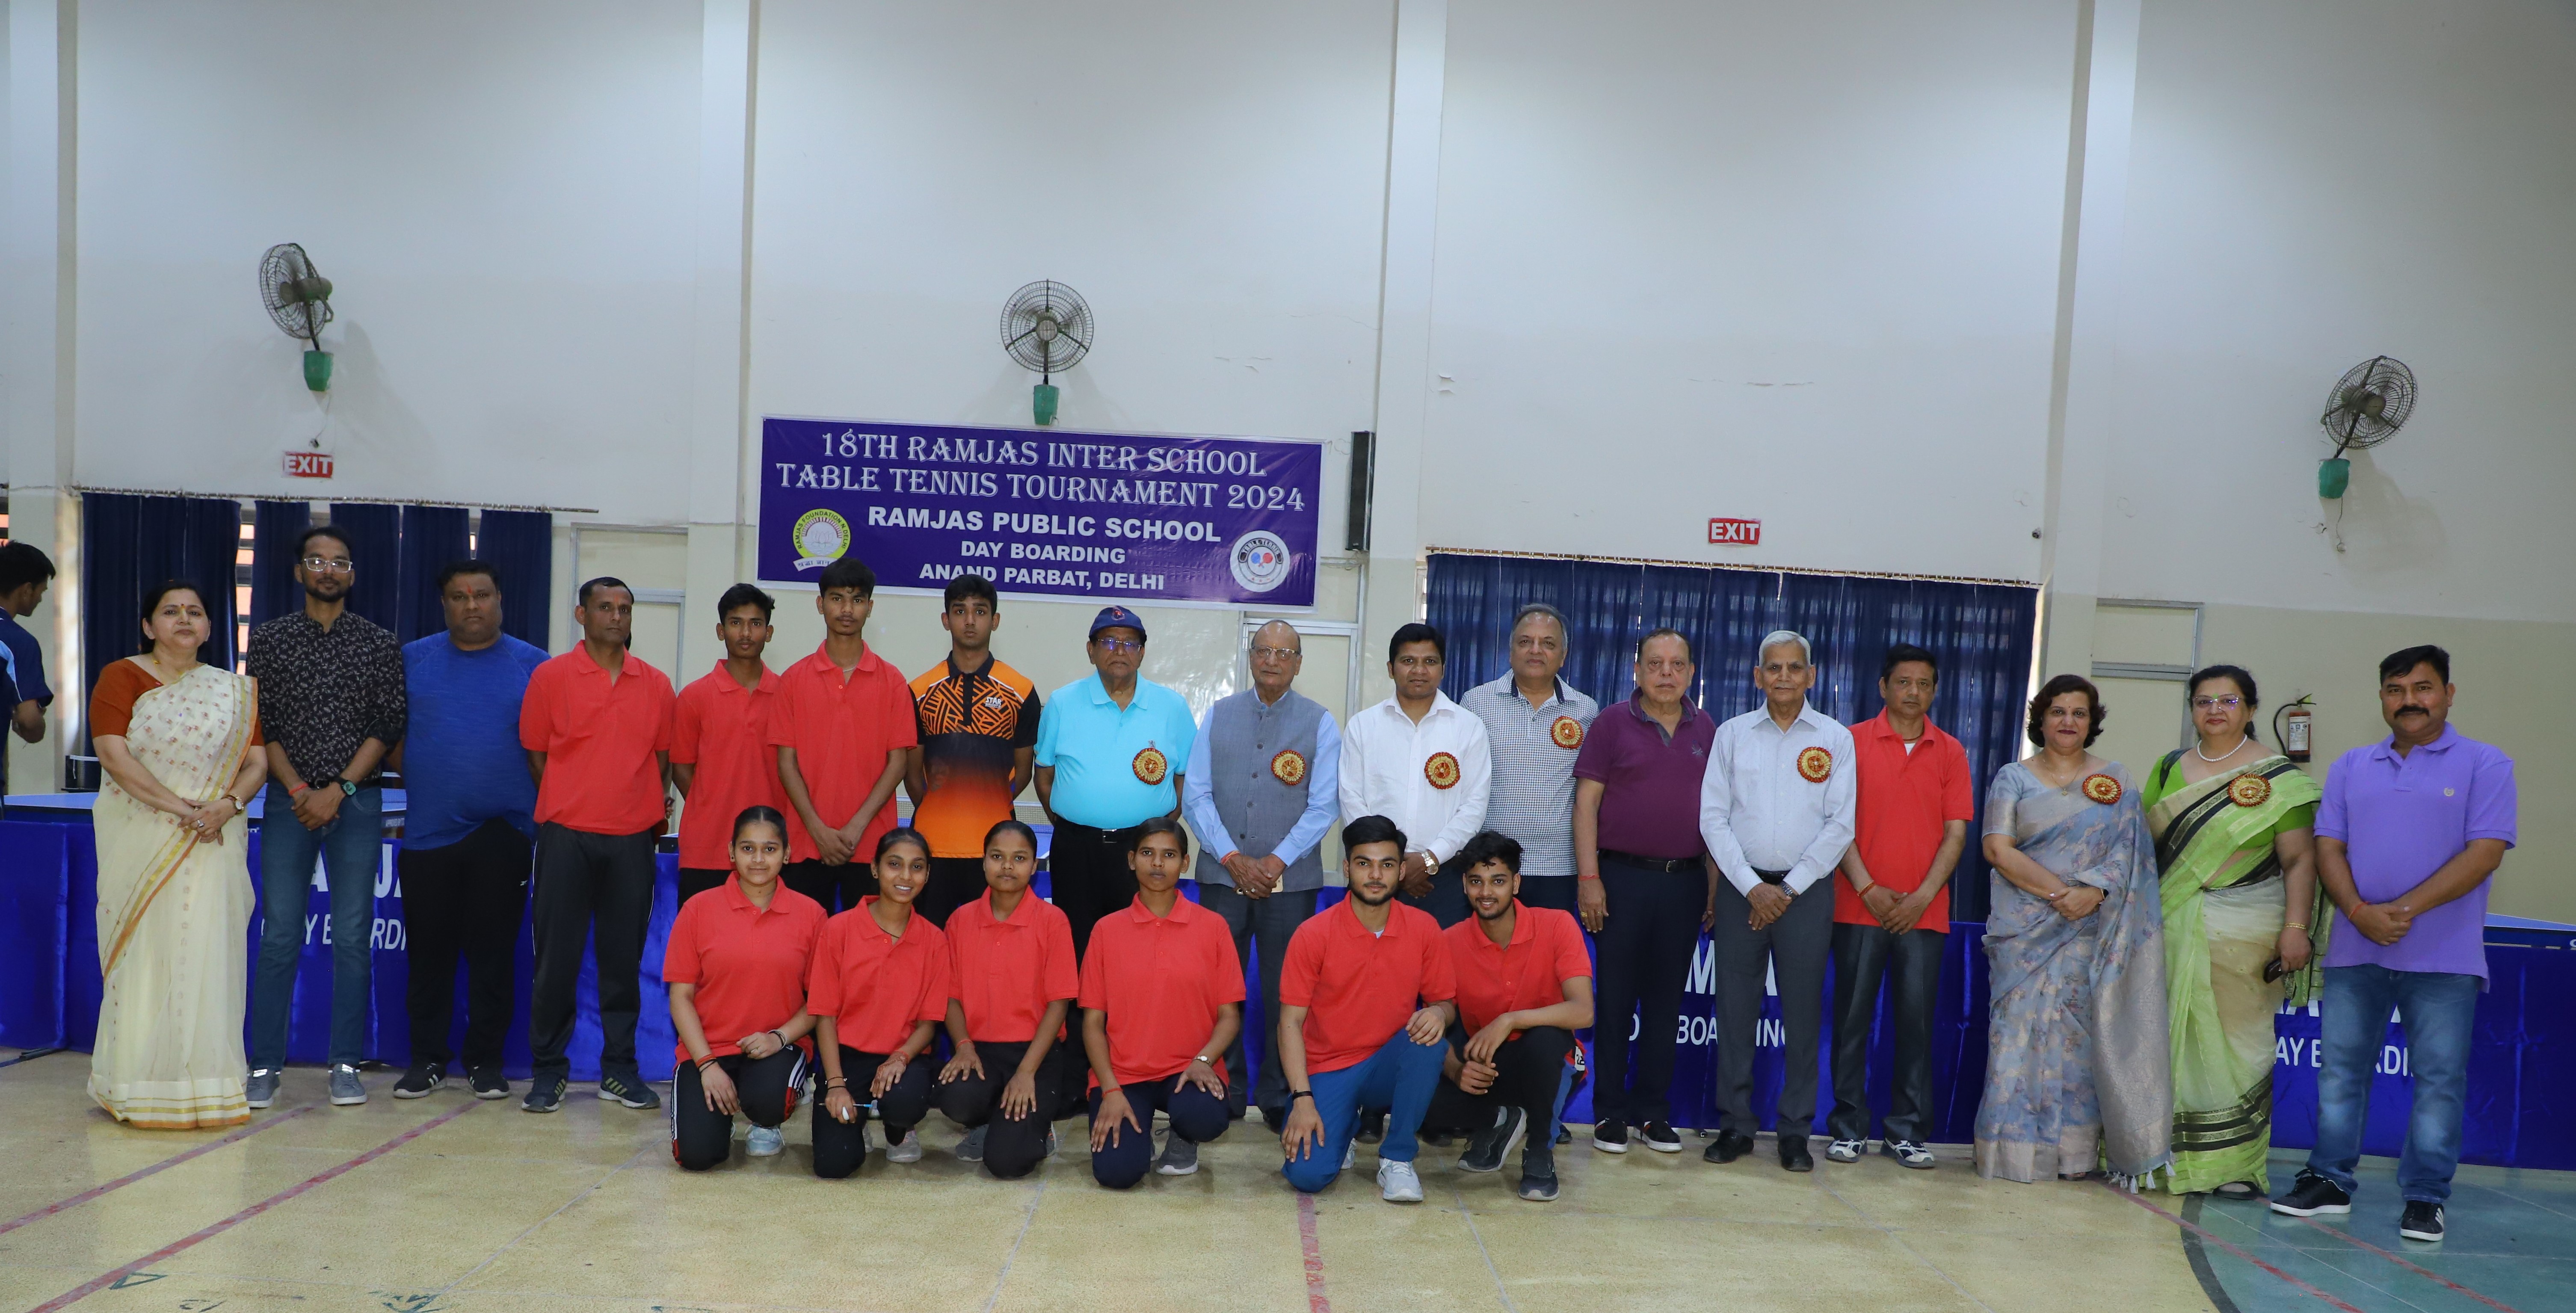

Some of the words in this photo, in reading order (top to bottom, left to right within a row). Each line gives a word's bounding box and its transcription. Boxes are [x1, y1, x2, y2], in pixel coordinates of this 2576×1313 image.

[822, 428, 898, 460] 18TH
[907, 436, 1039, 466] RAMJAS
[1048, 442, 1138, 471] INTER
[1147, 447, 1267, 476] SCHOOL
[284, 455, 332, 474] EXIT
[776, 462, 882, 491] TABLE
[889, 467, 999, 498] TENNIS
[1006, 473, 1219, 508] TOURNAMENT
[1227, 484, 1305, 511] 2024
[802, 511, 842, 523] FOUNDATION
[868, 506, 983, 531] RAMJAS
[992, 512, 1096, 537] PUBLIC
[1104, 517, 1221, 542] SCHOOL
[1711, 522, 1759, 541] EXIT
[961, 541, 1004, 558] DAY
[1010, 543, 1126, 564] BOARDING
[1004, 567, 1092, 591] PARBAT,
[1099, 571, 1164, 590] DELHI
[986, 697, 1001, 705] STAR
